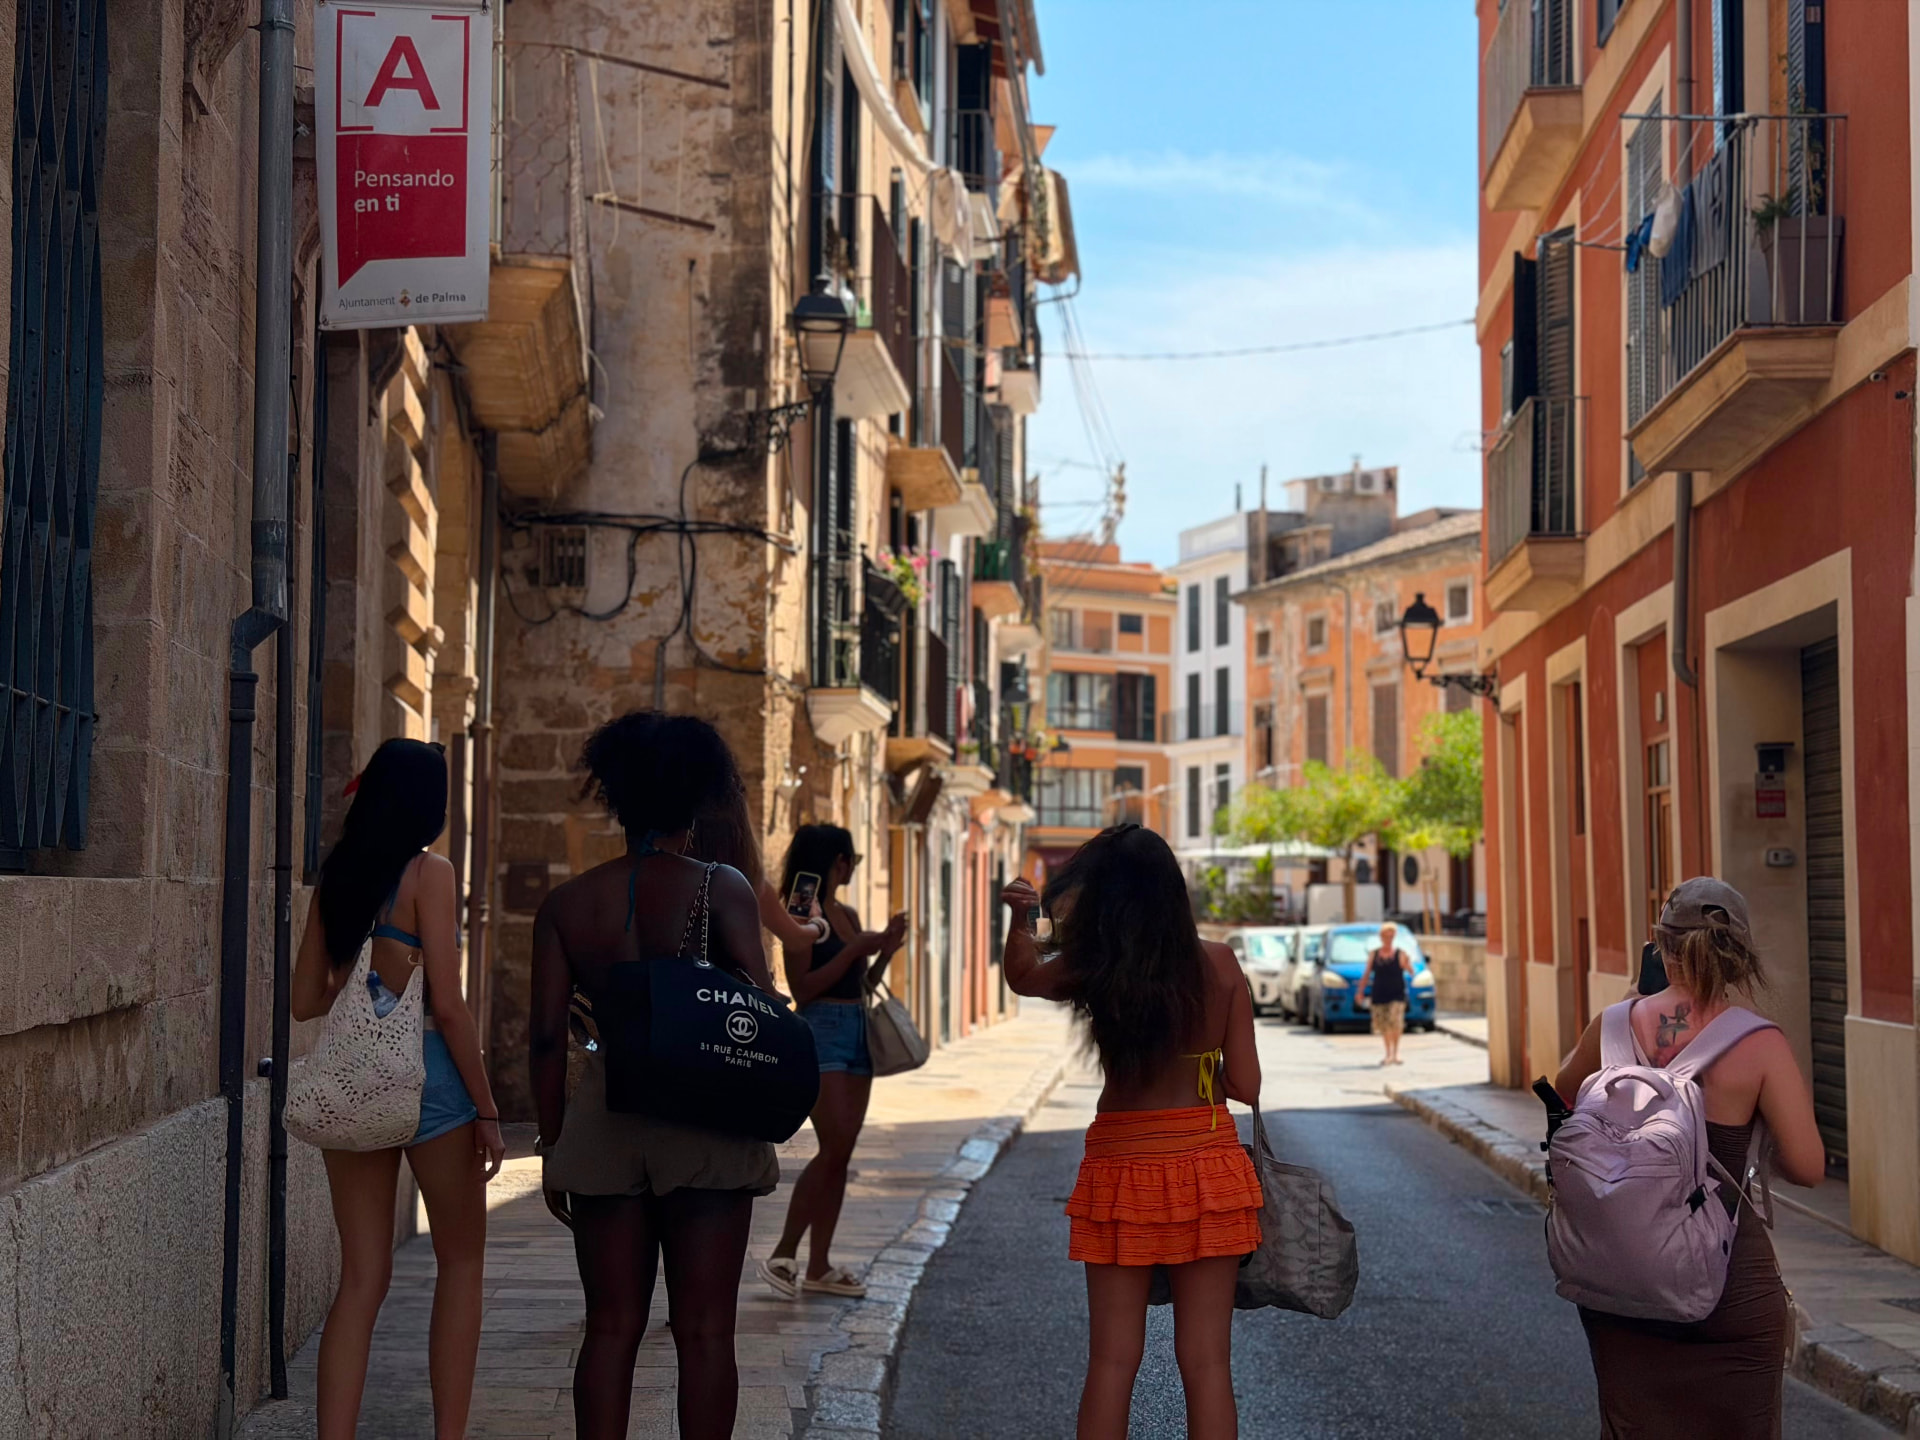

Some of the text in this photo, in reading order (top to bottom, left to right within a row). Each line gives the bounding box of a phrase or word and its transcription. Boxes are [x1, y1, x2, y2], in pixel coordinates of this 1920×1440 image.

[363, 35, 441, 110] A
[354, 168, 455, 188] Pensando
[354, 193, 400, 213] en ti
[338, 292, 466, 310] Ajuntament de Palma
[696, 988, 779, 1018] CHANEL
[713, 1044, 732, 1055] RUE
[736, 1048, 779, 1064] CAMBON
